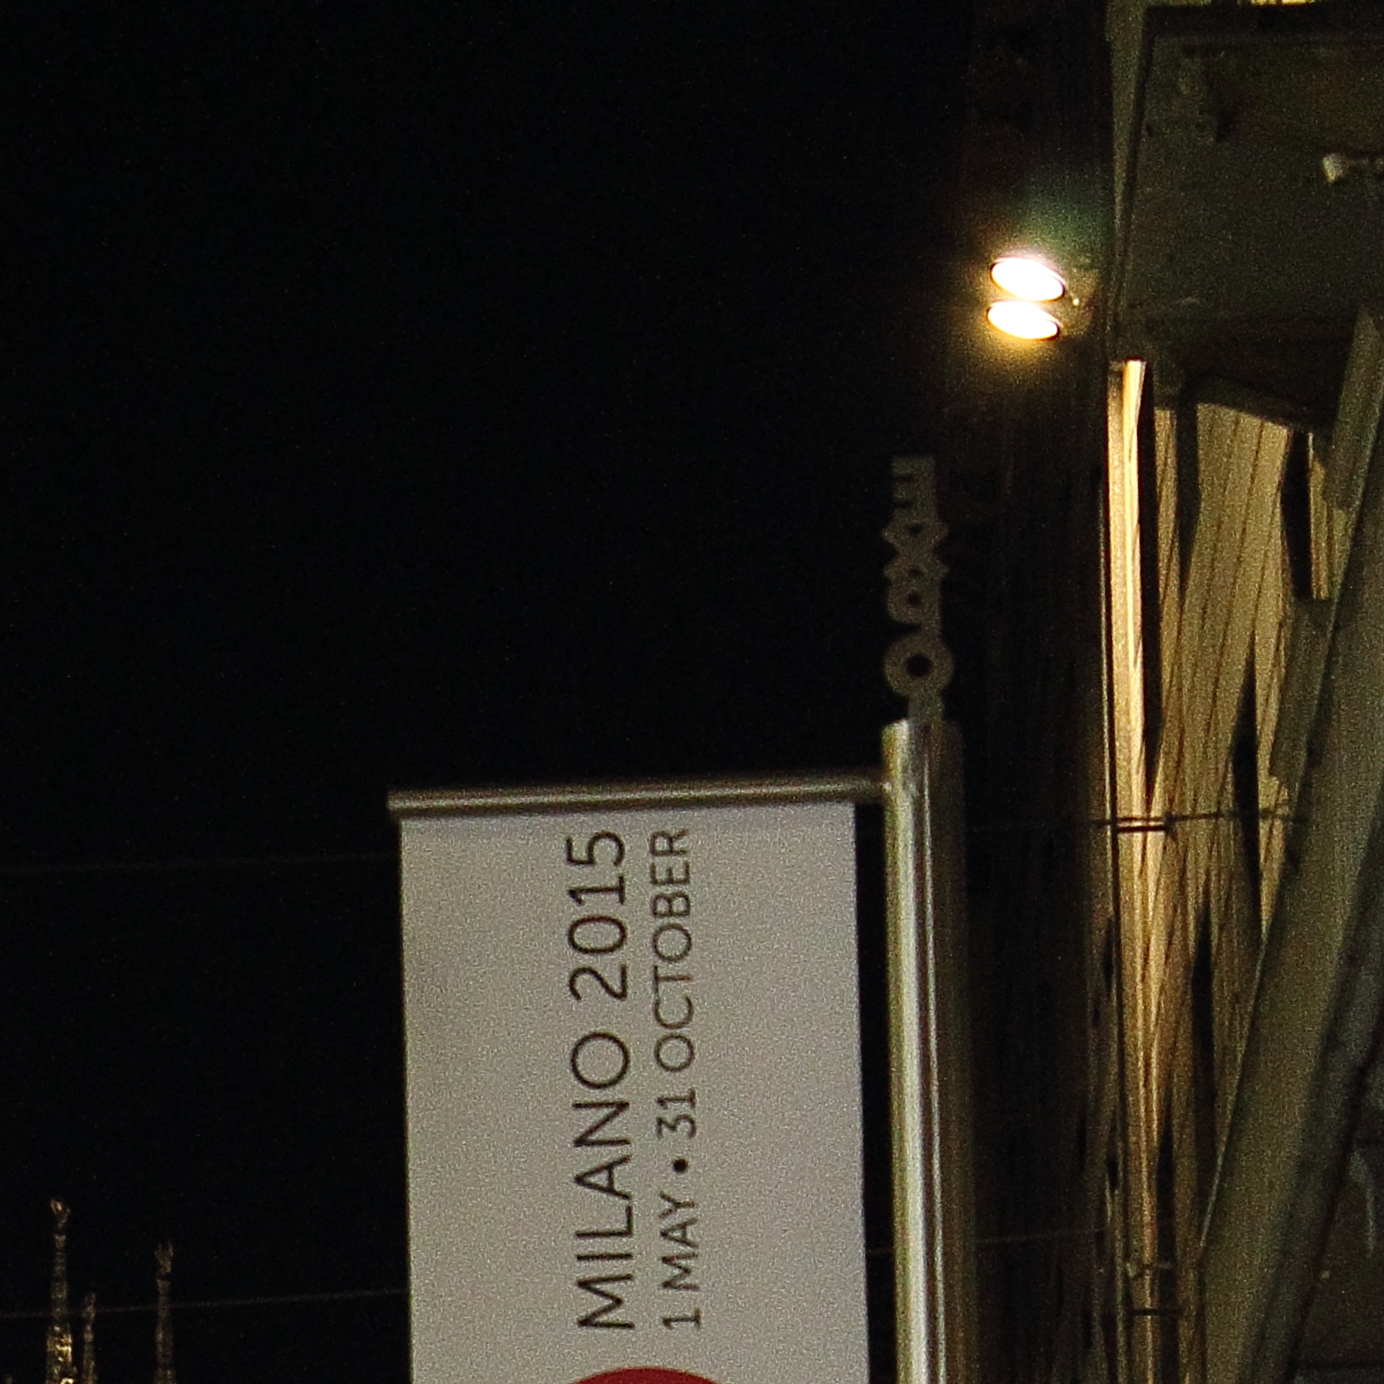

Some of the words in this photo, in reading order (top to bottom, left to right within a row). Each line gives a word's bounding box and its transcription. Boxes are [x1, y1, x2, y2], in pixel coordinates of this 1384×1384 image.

[563, 828, 630, 1003] 2015
[647, 827, 697, 1075] OCTOBER
[567, 1029, 637, 1333] MILANO
[654, 1088, 698, 1140] 31
[658, 1191, 700, 1292] MAY
[660, 1308, 703, 1331] 1
